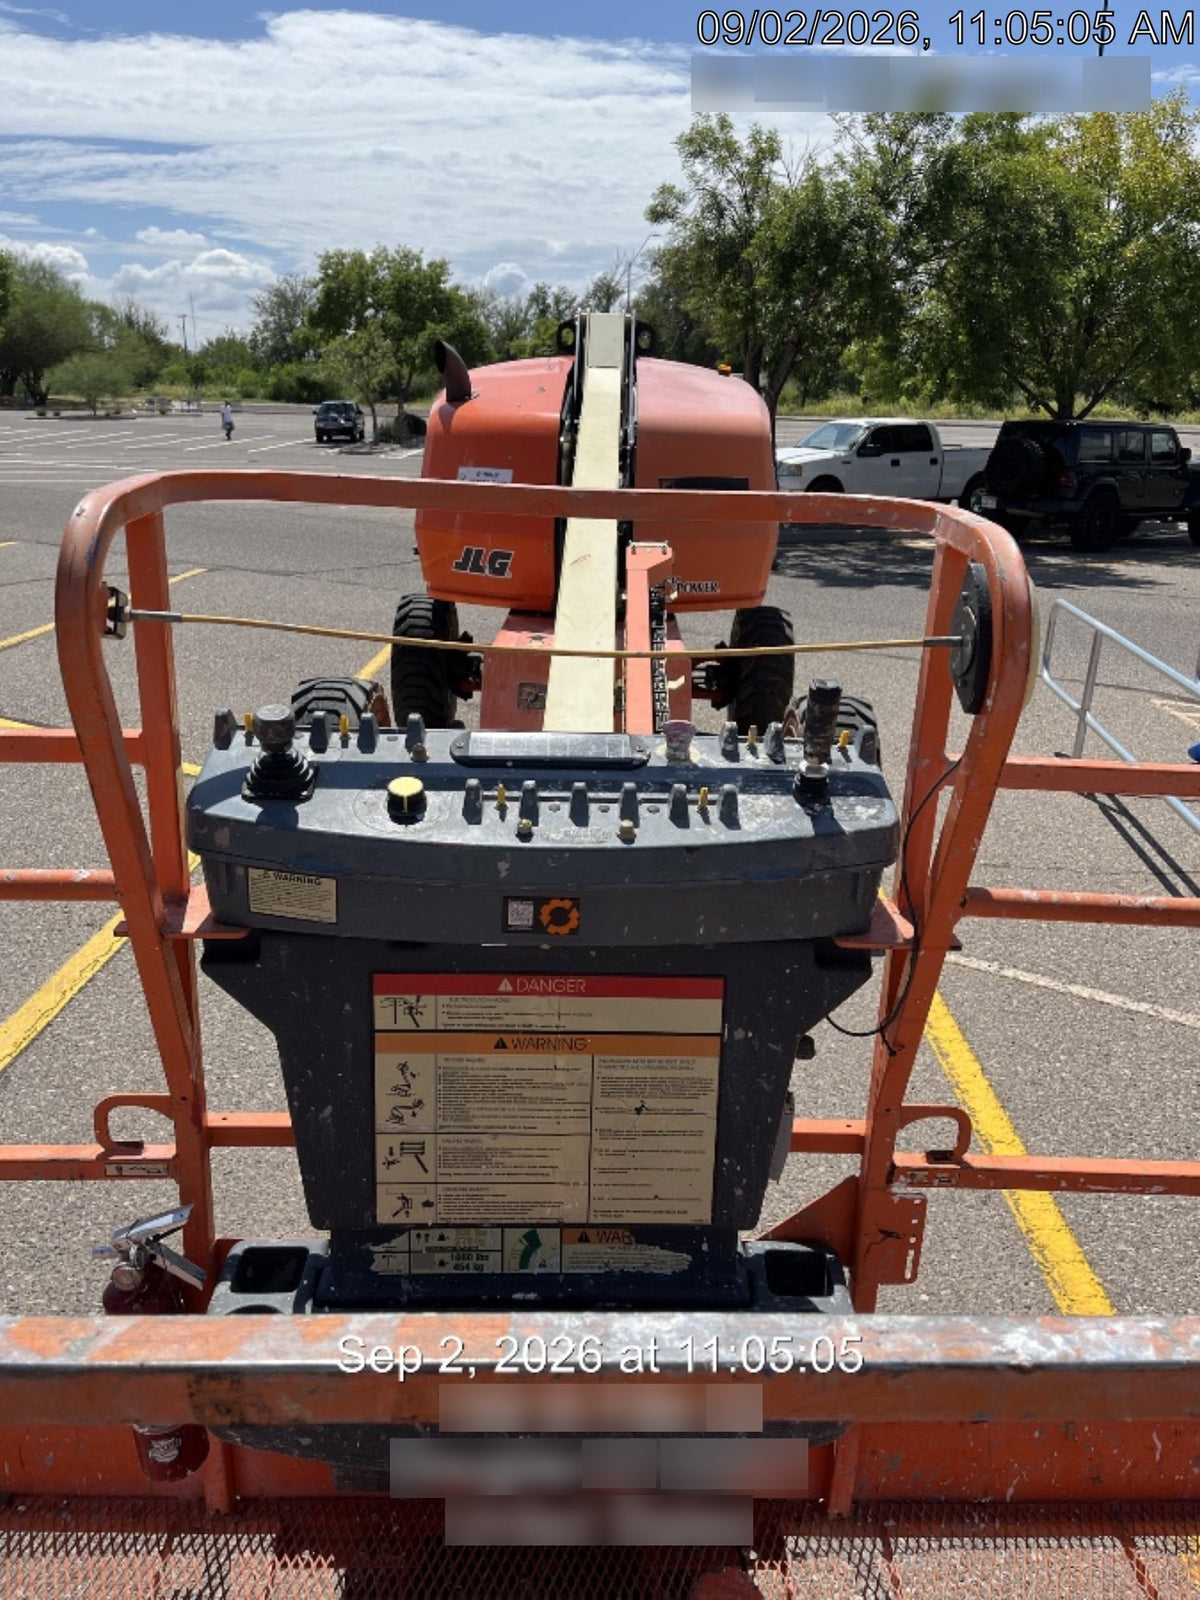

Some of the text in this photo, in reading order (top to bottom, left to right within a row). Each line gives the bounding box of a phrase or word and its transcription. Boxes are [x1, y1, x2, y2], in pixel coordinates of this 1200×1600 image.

[452, 546, 514, 578] JLG
[273, 872, 323, 886] WARNING
[516, 976, 587, 993] DANGER
[511, 1037, 588, 1051] WARNING
